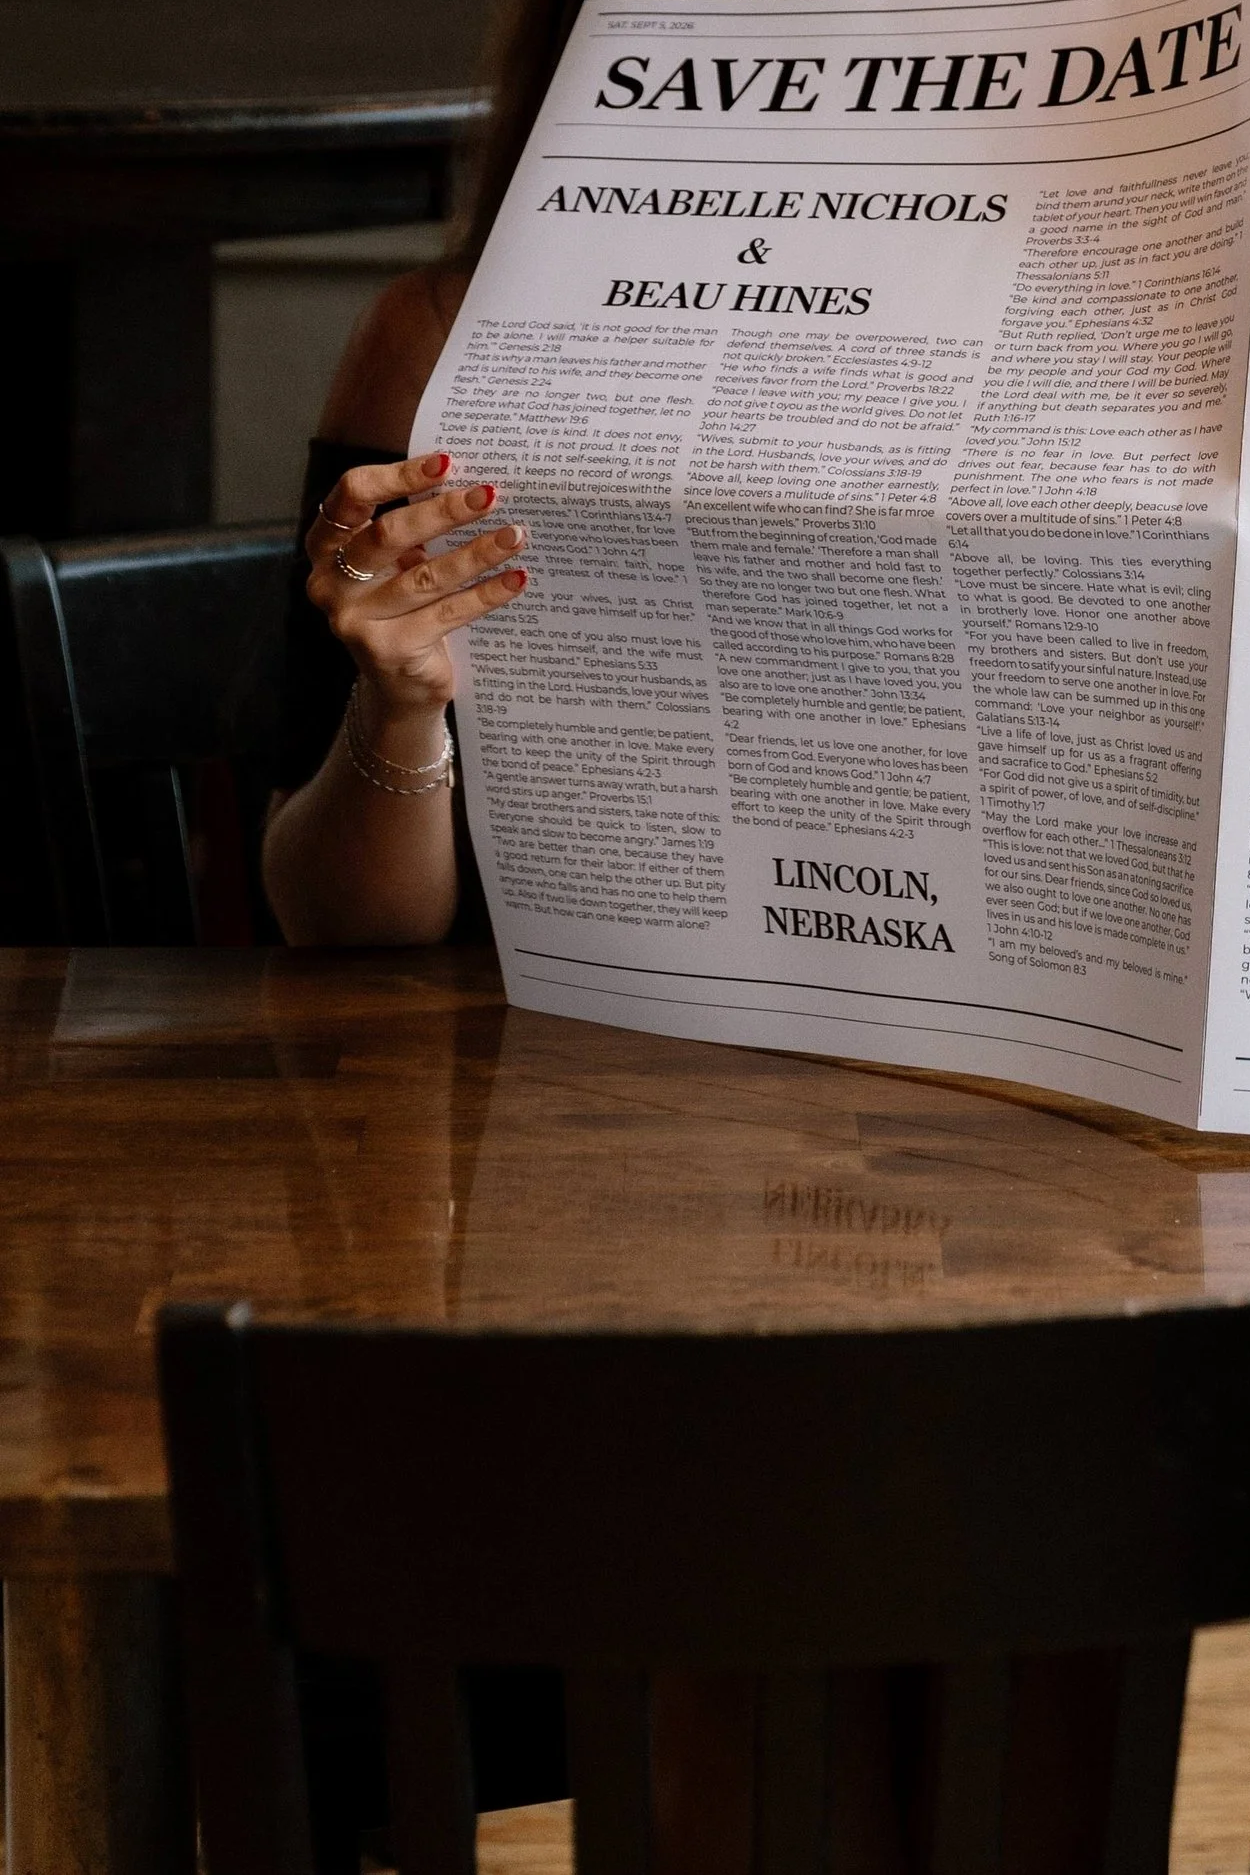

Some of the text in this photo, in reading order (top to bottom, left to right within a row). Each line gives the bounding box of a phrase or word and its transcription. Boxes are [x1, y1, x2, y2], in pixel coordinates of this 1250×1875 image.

[594, 4, 1244, 113] SAVE THE DATE
[538, 185, 1008, 224] ANNABELLE NICHOLS
[737, 238, 772, 266] &
[1026, 235, 1100, 246] Proverbs 3:3-4
[1015, 270, 1110, 281] Thessalonians 5:11
[602, 278, 873, 317] BEAU HINES
[1004, 305, 1054, 318] forgiving
[1060, 306, 1088, 317] each
[1130, 304, 1151, 316] just
[1157, 304, 1169, 312] as
[1174, 300, 1184, 310] in
[1189, 293, 1216, 308] Christ
[1221, 286, 1238, 299] God
[472, 330, 483, 339] to
[486, 332, 500, 340] be
[546, 332, 565, 342] will
[569, 333, 599, 343] make
[614, 334, 646, 346] helper
[652, 337, 695, 347] suitable
[699, 338, 715, 348] for
[731, 328, 773, 340] Though
[778, 331, 800, 339] one
[805, 332, 830, 341] may
[835, 332, 850, 341] be
[935, 336, 957, 346] two
[962, 338, 984, 348] can
[699, 422, 757, 433] John 14:27
[960, 605, 972, 614] in
[977, 605, 1028, 618] brotherly
[1065, 609, 1101, 620] Honor
[1106, 611, 1129, 621] one
[1134, 611, 1176, 624] another
[1182, 615, 1211, 628] above
[488, 810, 534, 825] Everyone
[538, 815, 573, 826] should
[578, 817, 592, 827] be
[596, 819, 625, 832] quick
[630, 822, 641, 831] to
[681, 824, 706, 836] slow
[710, 827, 722, 837] to
[731, 801, 972, 832] effort to keep the unity of the Spirit through
[772, 856, 939, 906] LINCOLN,
[762, 905, 956, 955] NEBRASKA
[988, 951, 1087, 976] Song of Solomon 8:3
